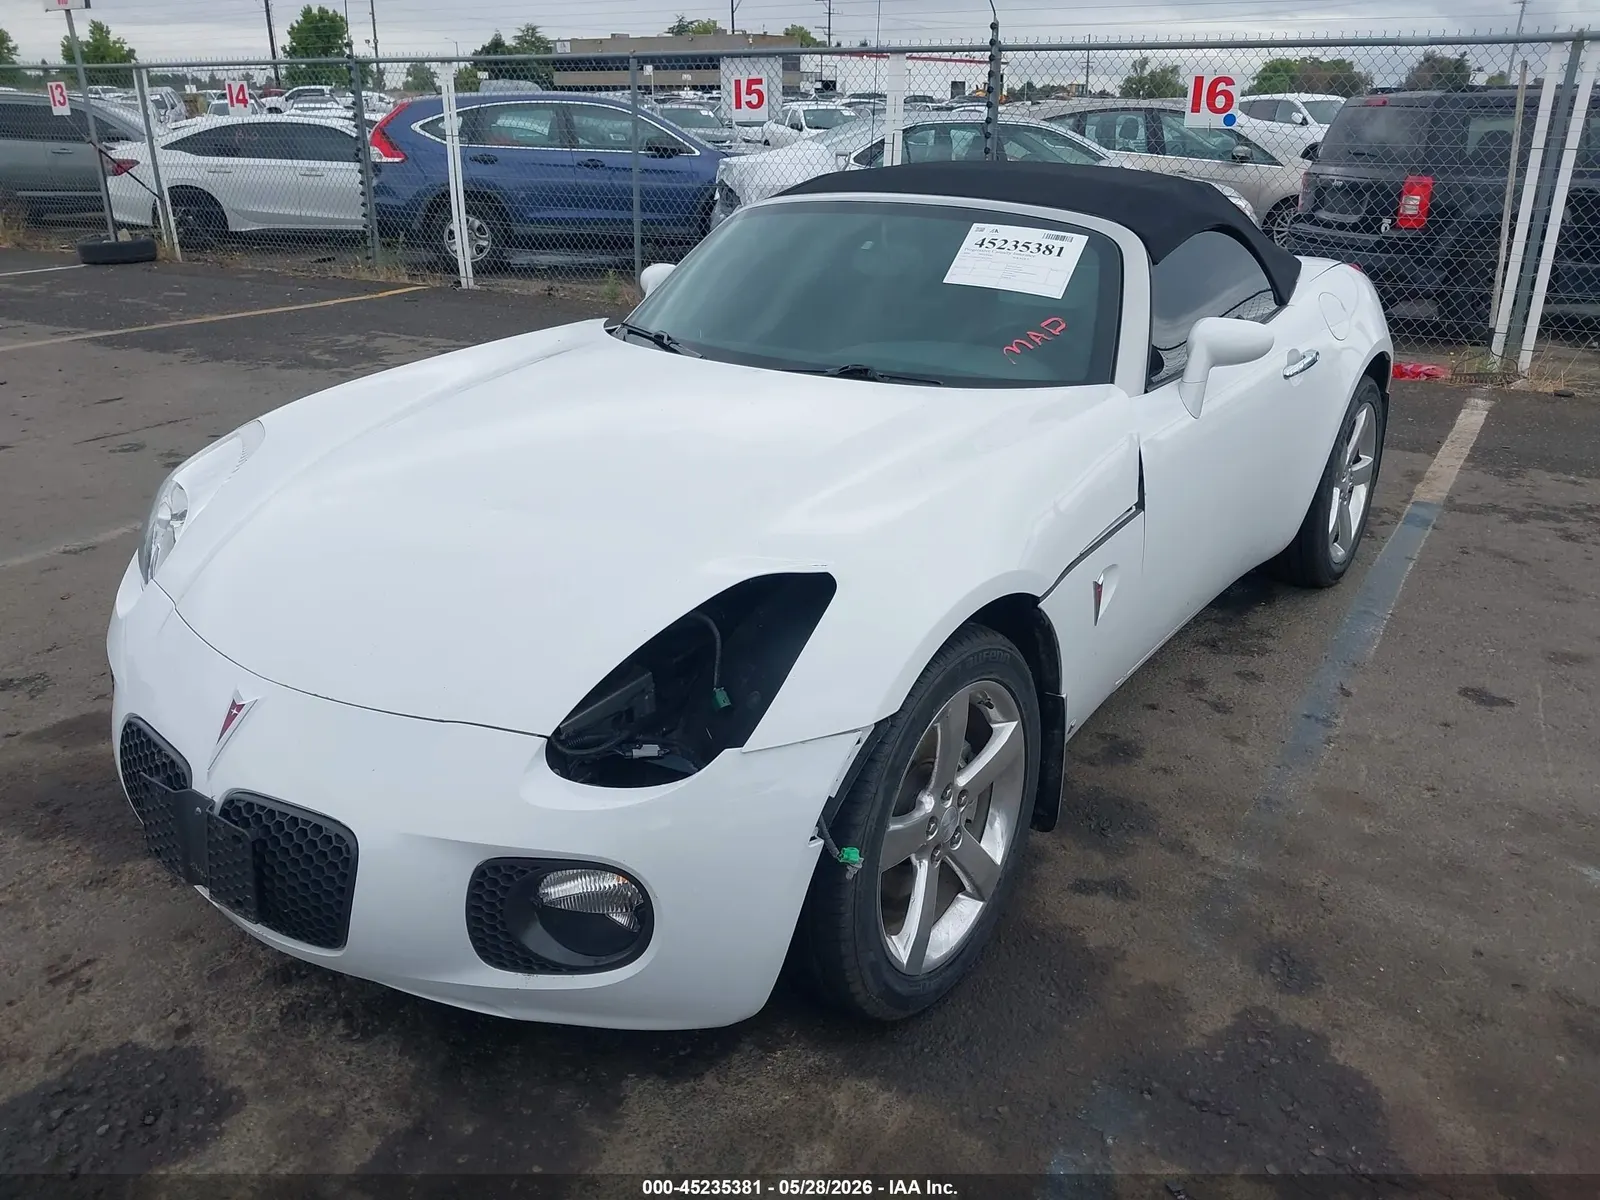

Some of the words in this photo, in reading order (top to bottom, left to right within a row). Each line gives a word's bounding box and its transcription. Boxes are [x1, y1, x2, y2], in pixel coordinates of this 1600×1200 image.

[50, 84, 66, 106] 13
[227, 84, 248, 108] 14
[734, 78, 765, 110] 15
[1190, 75, 1235, 115] 16
[974, 236, 1065, 257] 45235381
